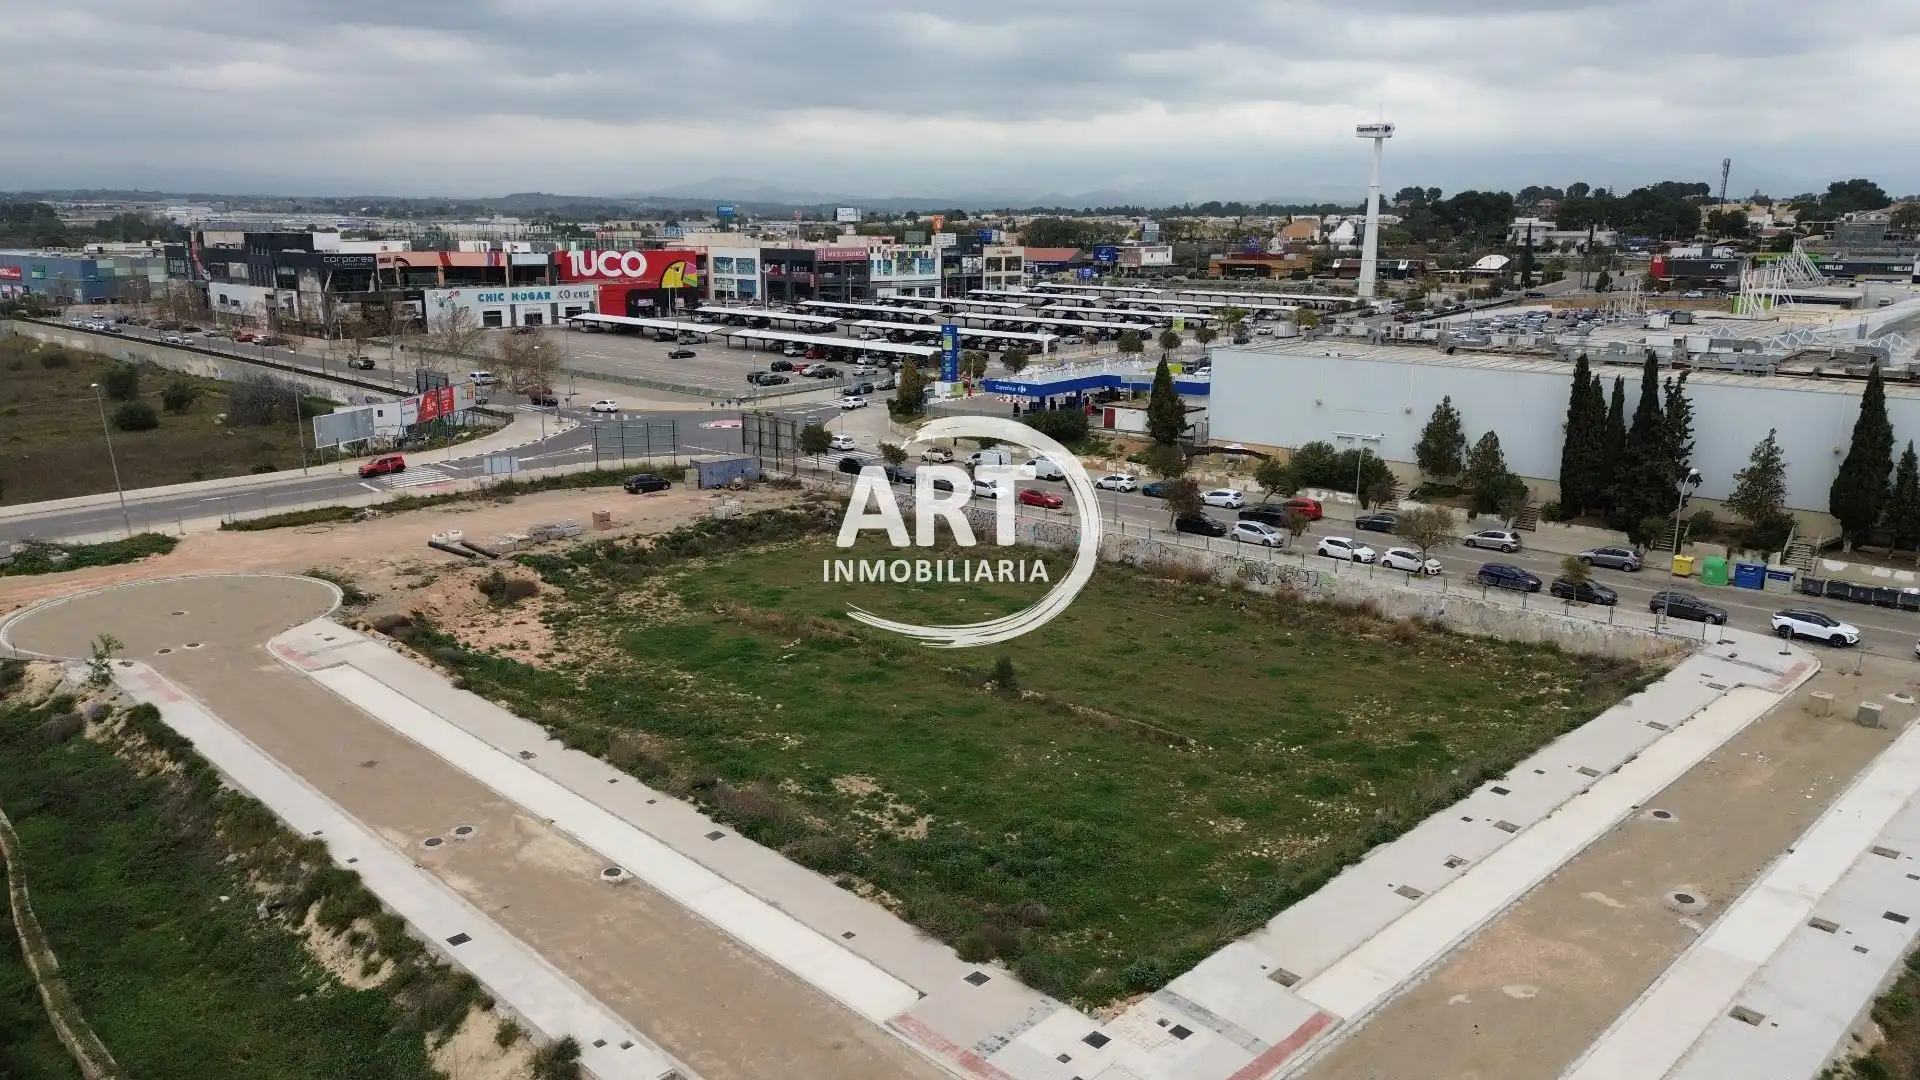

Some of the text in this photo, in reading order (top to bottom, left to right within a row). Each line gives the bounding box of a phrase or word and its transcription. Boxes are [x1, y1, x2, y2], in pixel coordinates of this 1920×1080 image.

[567, 250, 647, 278] TUCO
[478, 291, 552, 302] CHIC HOGAR
